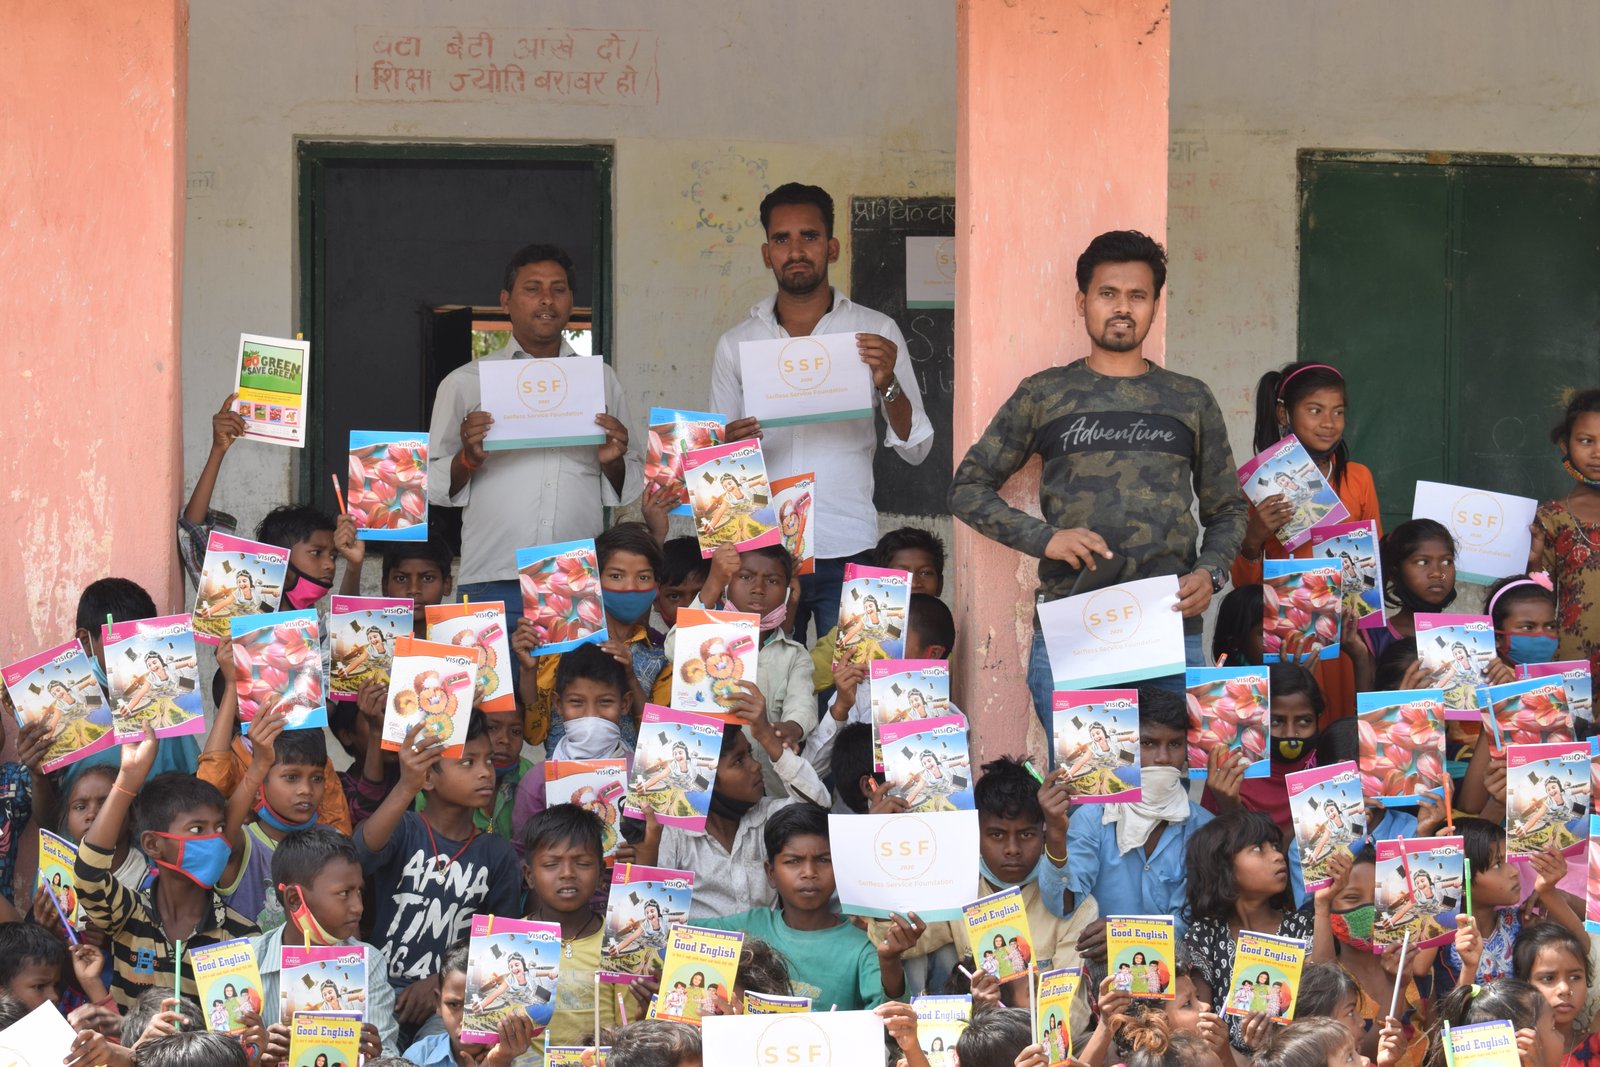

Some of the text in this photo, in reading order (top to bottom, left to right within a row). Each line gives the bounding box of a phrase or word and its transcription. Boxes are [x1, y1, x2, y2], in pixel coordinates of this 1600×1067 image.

[247, 366, 296, 381] SAVE GREEN
[260, 355, 301, 375] GREEN
[1060, 416, 1176, 451] Adventure
[1104, 700, 1131, 709] VISION
[396, 849, 490, 905] APNA
[968, 912, 988, 926] Good
[989, 903, 1020, 919] English
[1111, 928, 1168, 940] Good English
[674, 938, 736, 959] Good English
[1240, 944, 1297, 963] Good English
[196, 952, 251, 972] Good English
[917, 1010, 966, 1022] ood English
[296, 1025, 355, 1039] Good English
[1474, 1035, 1511, 1050] English
